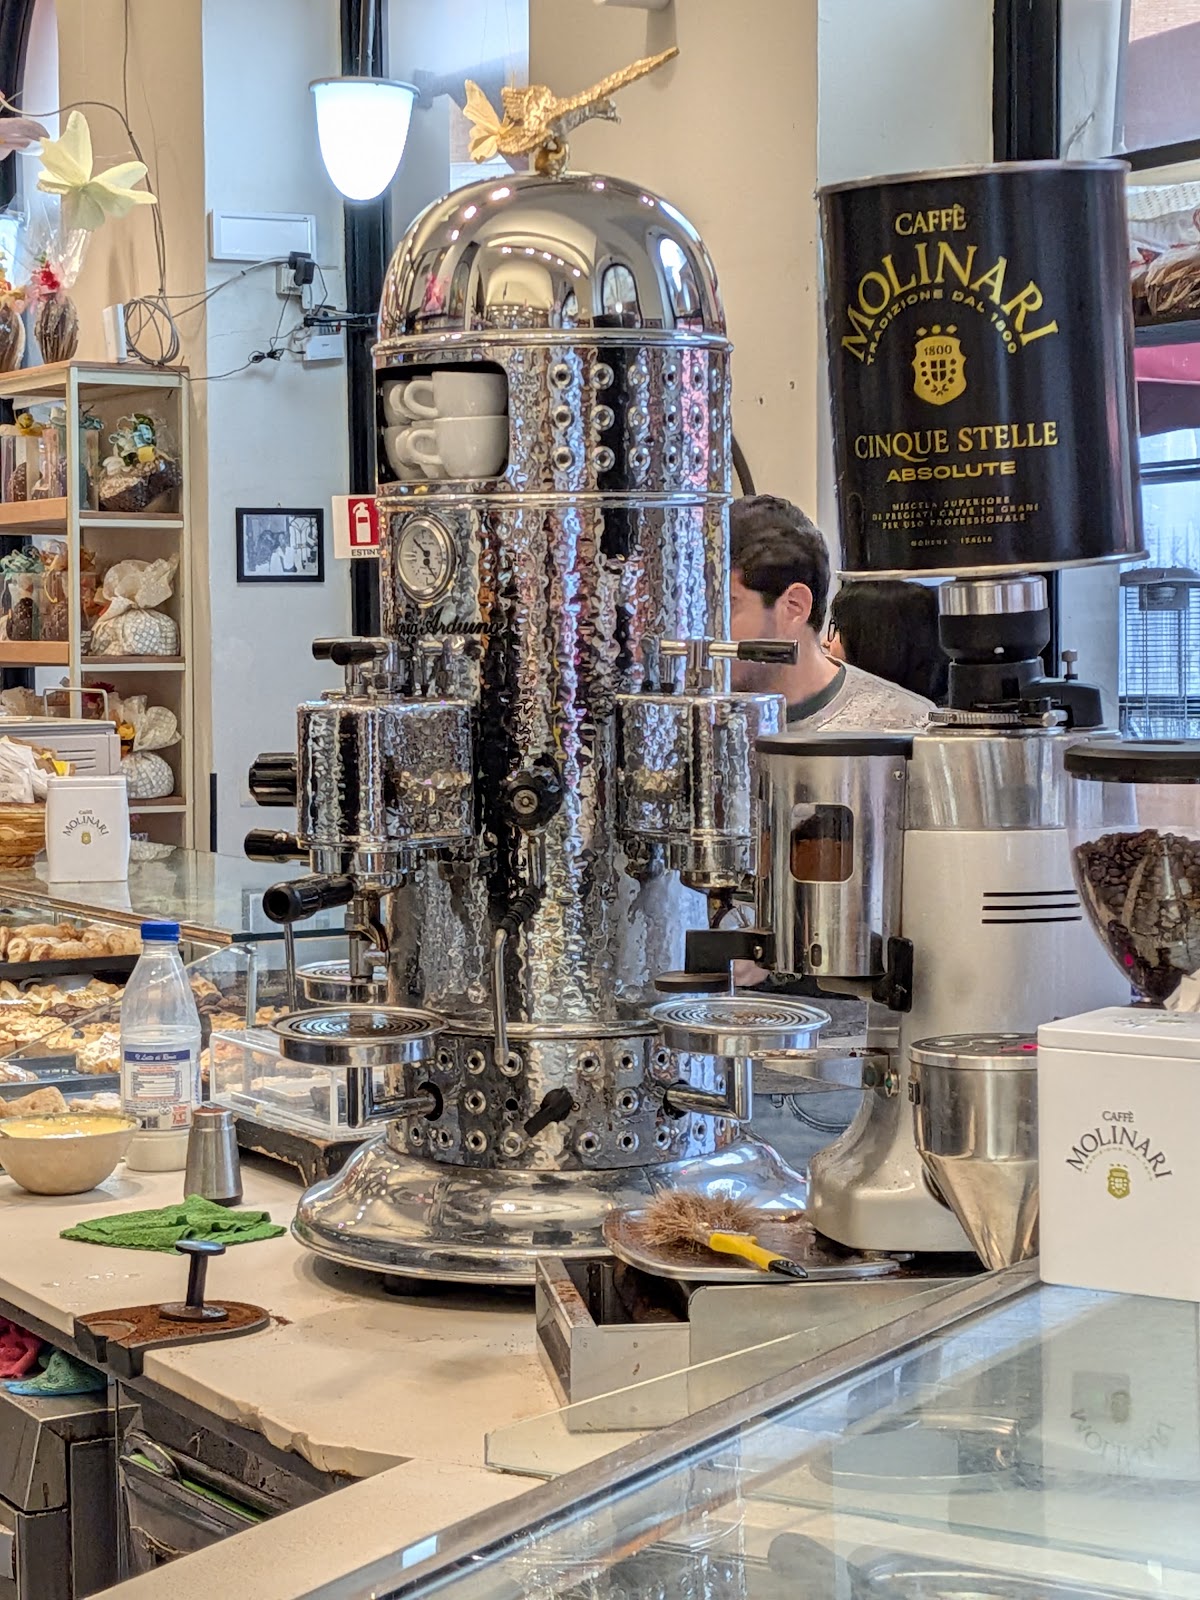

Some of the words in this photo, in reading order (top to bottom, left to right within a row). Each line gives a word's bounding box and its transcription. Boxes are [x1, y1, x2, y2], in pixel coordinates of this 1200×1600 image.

[841, 241, 1059, 362] MOLINARI
[952, 290, 985, 313] DAL
[923, 344, 953, 356] 1800
[855, 430, 949, 463] CINQUE
[958, 421, 1059, 453] STELLE
[886, 461, 1017, 483] ABSOLUTE
[62, 815, 109, 836] MOLINARI
[1102, 1110, 1135, 1123] CAFFÈ
[1065, 1125, 1173, 1178] MOLINARI
